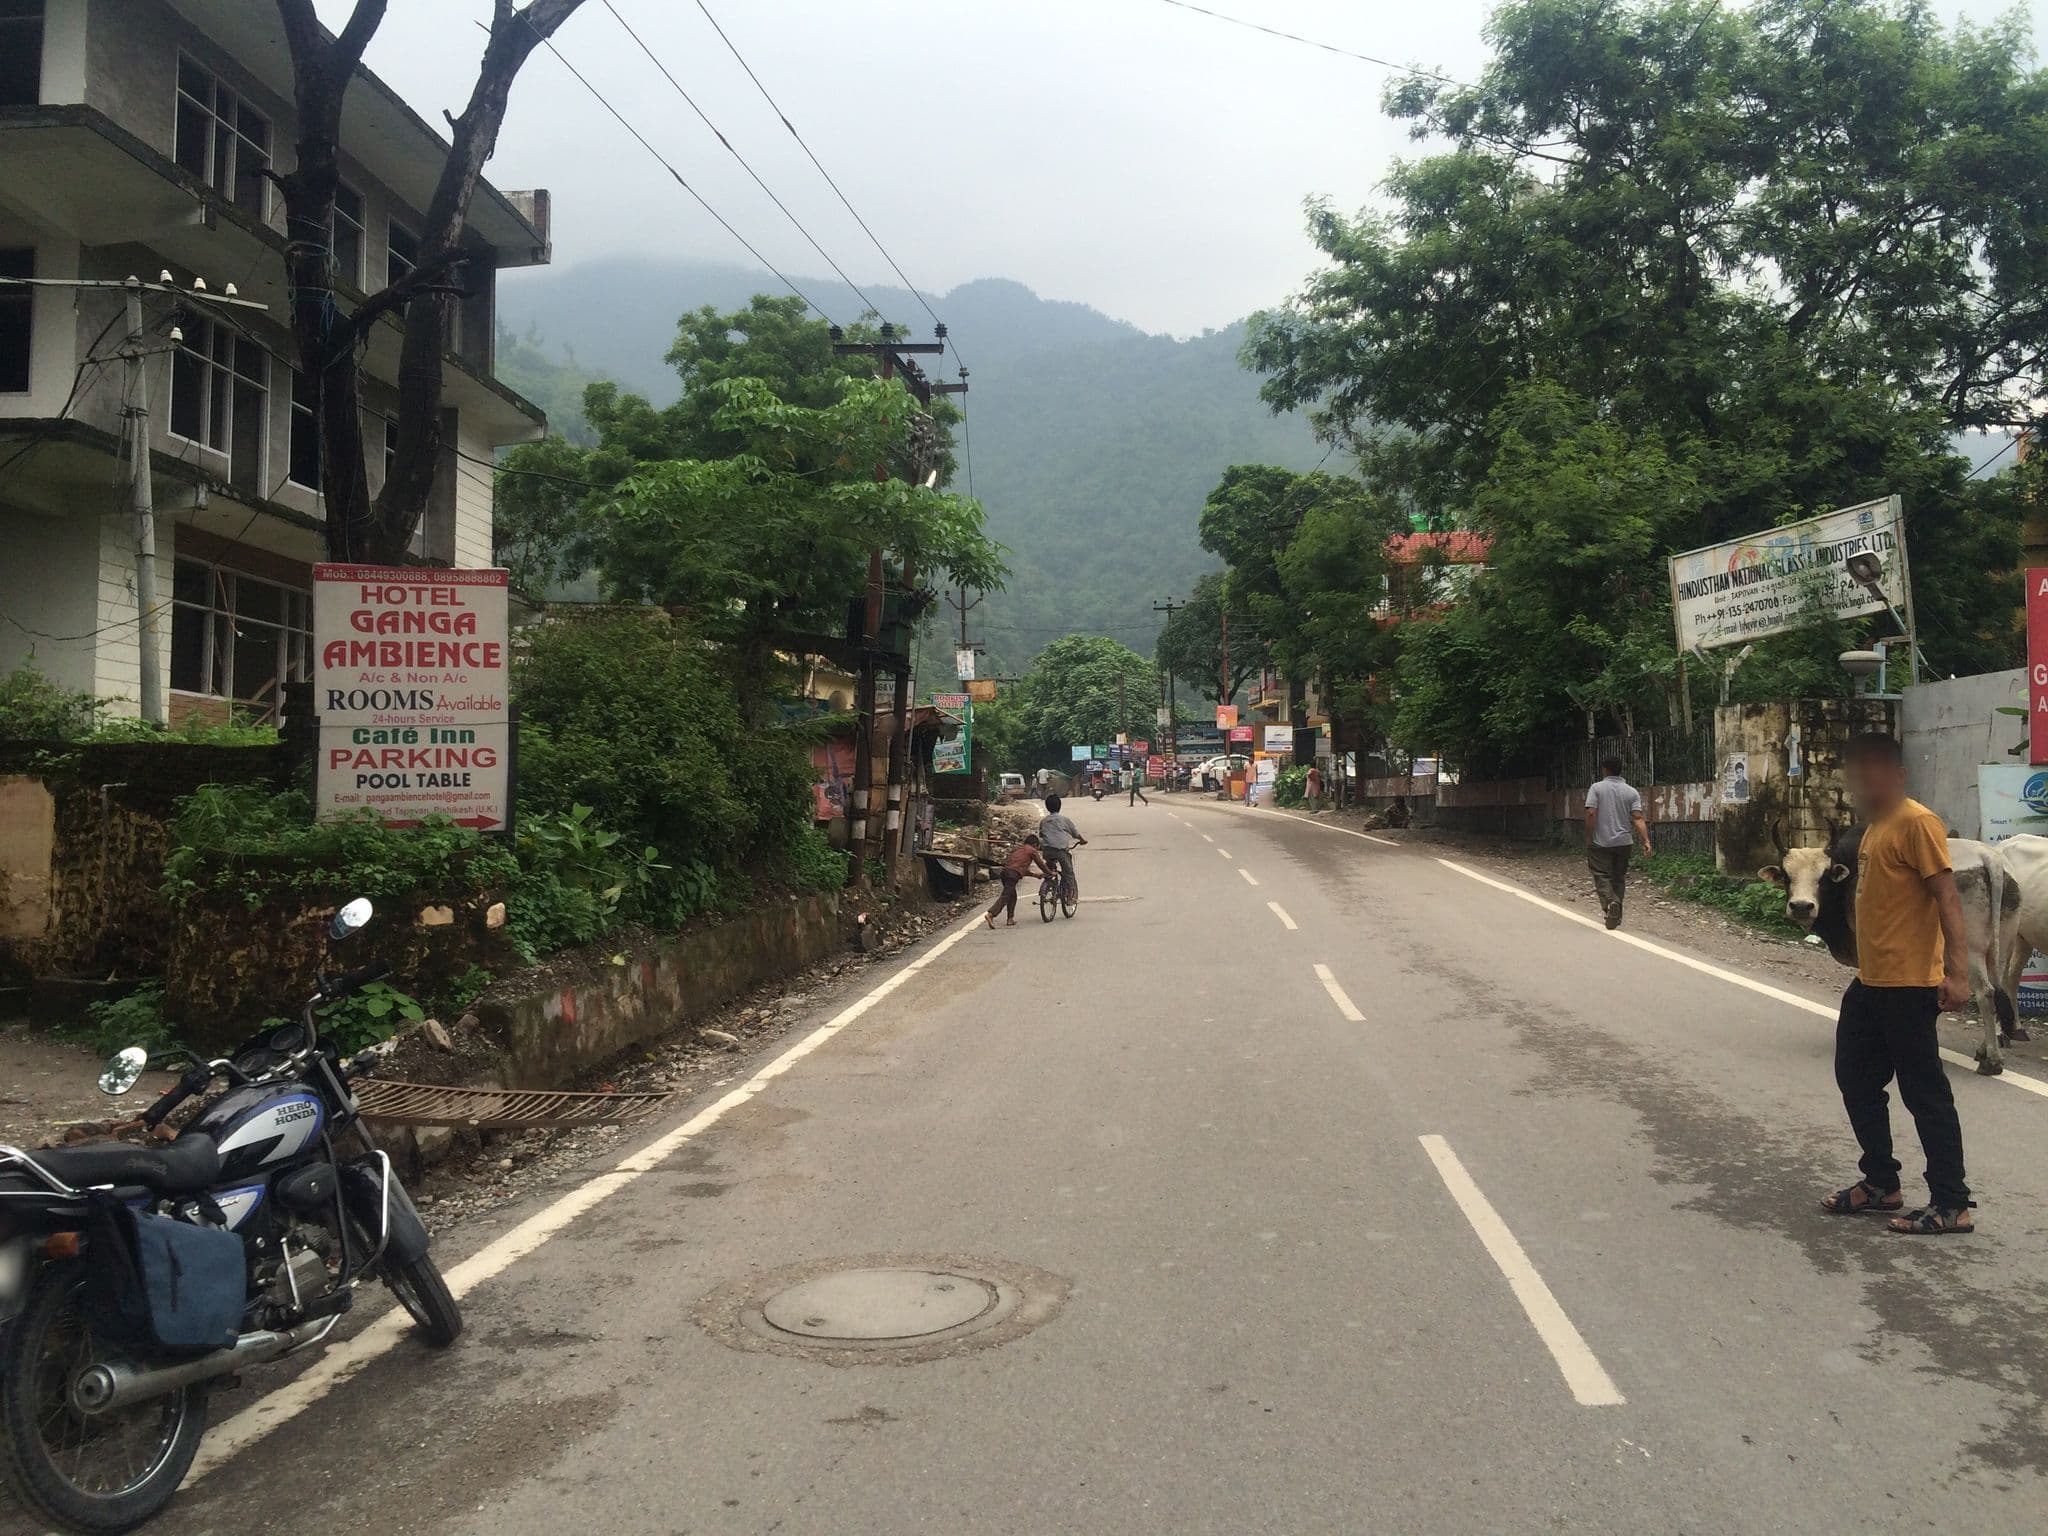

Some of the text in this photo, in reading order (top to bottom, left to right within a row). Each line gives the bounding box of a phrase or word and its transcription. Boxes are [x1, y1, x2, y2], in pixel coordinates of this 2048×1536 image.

[1677, 571, 1731, 601] HINDUSTHAN
[1731, 563, 1774, 588] NATIONAL
[1815, 536, 1868, 567] INDUSTRIES
[361, 585, 465, 606] HOTEL
[350, 610, 476, 637] GANGA
[323, 640, 502, 670] AMBIENCE
[359, 672, 468, 684] A/c & Non A/c
[326, 689, 502, 712] ROOMS Available
[372, 714, 455, 724] 24-hours Service
[352, 726, 475, 745] Café Inn
[330, 747, 497, 770] PARKING
[356, 772, 472, 789] POOL TABLE
[275, 1109, 316, 1126] HONDA
[276, 1100, 311, 1116] HERO
